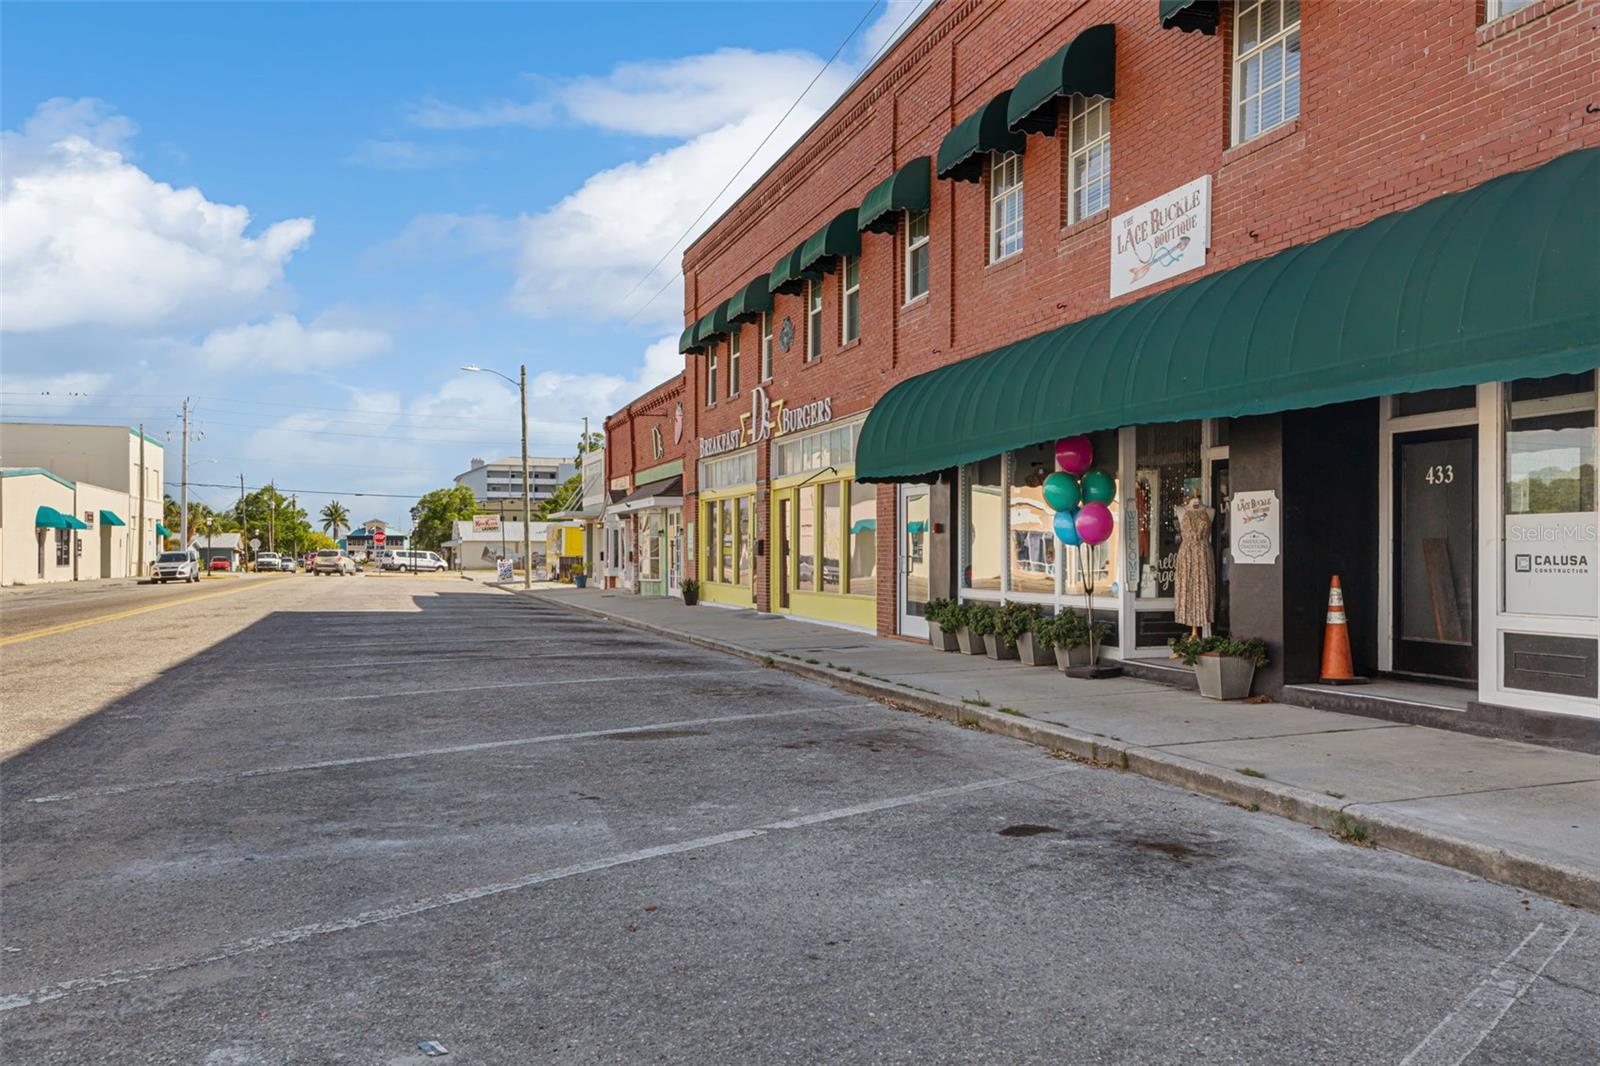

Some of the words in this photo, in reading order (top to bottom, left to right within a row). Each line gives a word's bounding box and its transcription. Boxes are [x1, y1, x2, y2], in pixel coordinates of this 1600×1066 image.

[1117, 220, 1149, 255] LACE
[1150, 189, 1201, 235] BUCKLE
[1154, 214, 1198, 249] BOUTIQUE
[700, 429, 740, 458] BREAKFAST
[782, 397, 832, 433] BURGERS
[1425, 464, 1454, 485] 433
[1127, 511, 1138, 580] WELCOME
[1534, 555, 1588, 567] CALUSA
